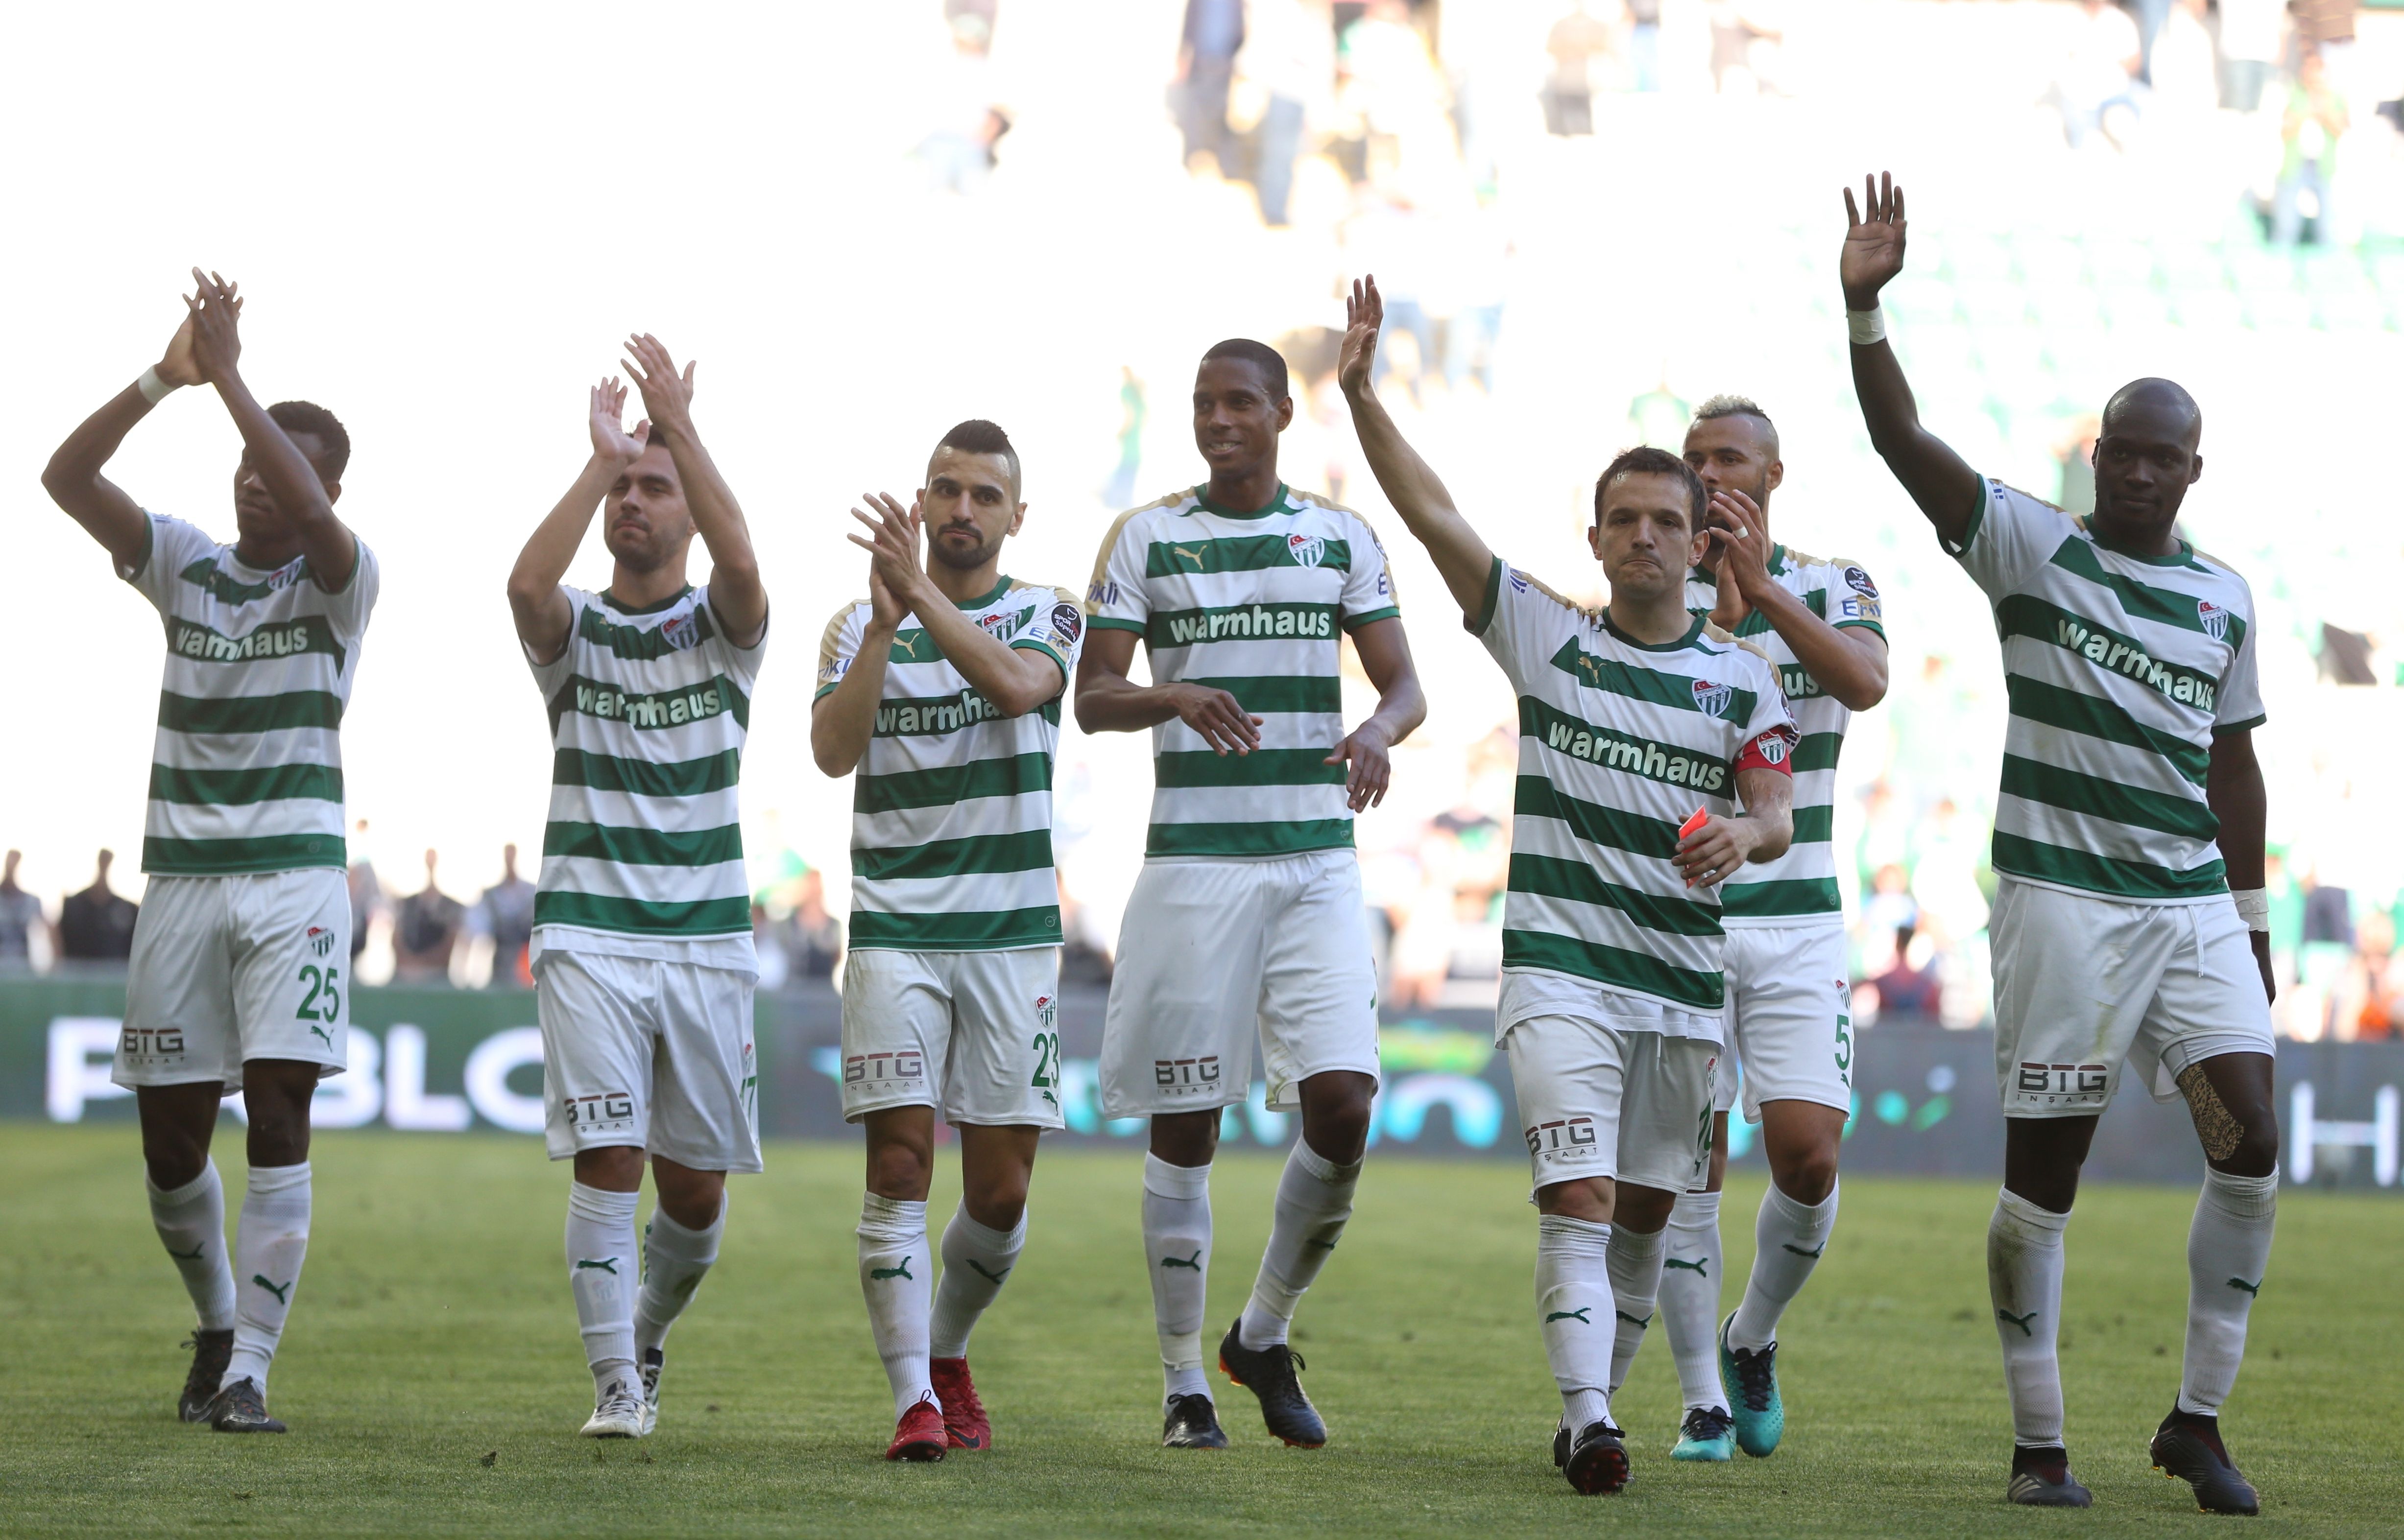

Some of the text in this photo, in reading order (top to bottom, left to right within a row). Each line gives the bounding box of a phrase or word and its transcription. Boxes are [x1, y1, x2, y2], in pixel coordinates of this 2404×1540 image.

[1054, 614, 1071, 626] SPOR
[1170, 605, 1330, 643] warmhaus
[2059, 619, 2214, 711] warmhaus
[577, 685, 720, 726] warmhaus
[876, 691, 1000, 733] warmha
[1549, 722, 1725, 790] warmhaus
[296, 965, 339, 1024] 25
[124, 1029, 184, 1054] BTG
[1032, 1033, 1058, 1089] 23
[1835, 1015, 1850, 1071] 5
[845, 1051, 922, 1084] BTG
[1155, 1056, 1220, 1085] BTG
[2019, 1062, 2107, 1092] BTG
[564, 1092, 632, 1125] BTG
[1525, 1117, 1595, 1157] BTG
